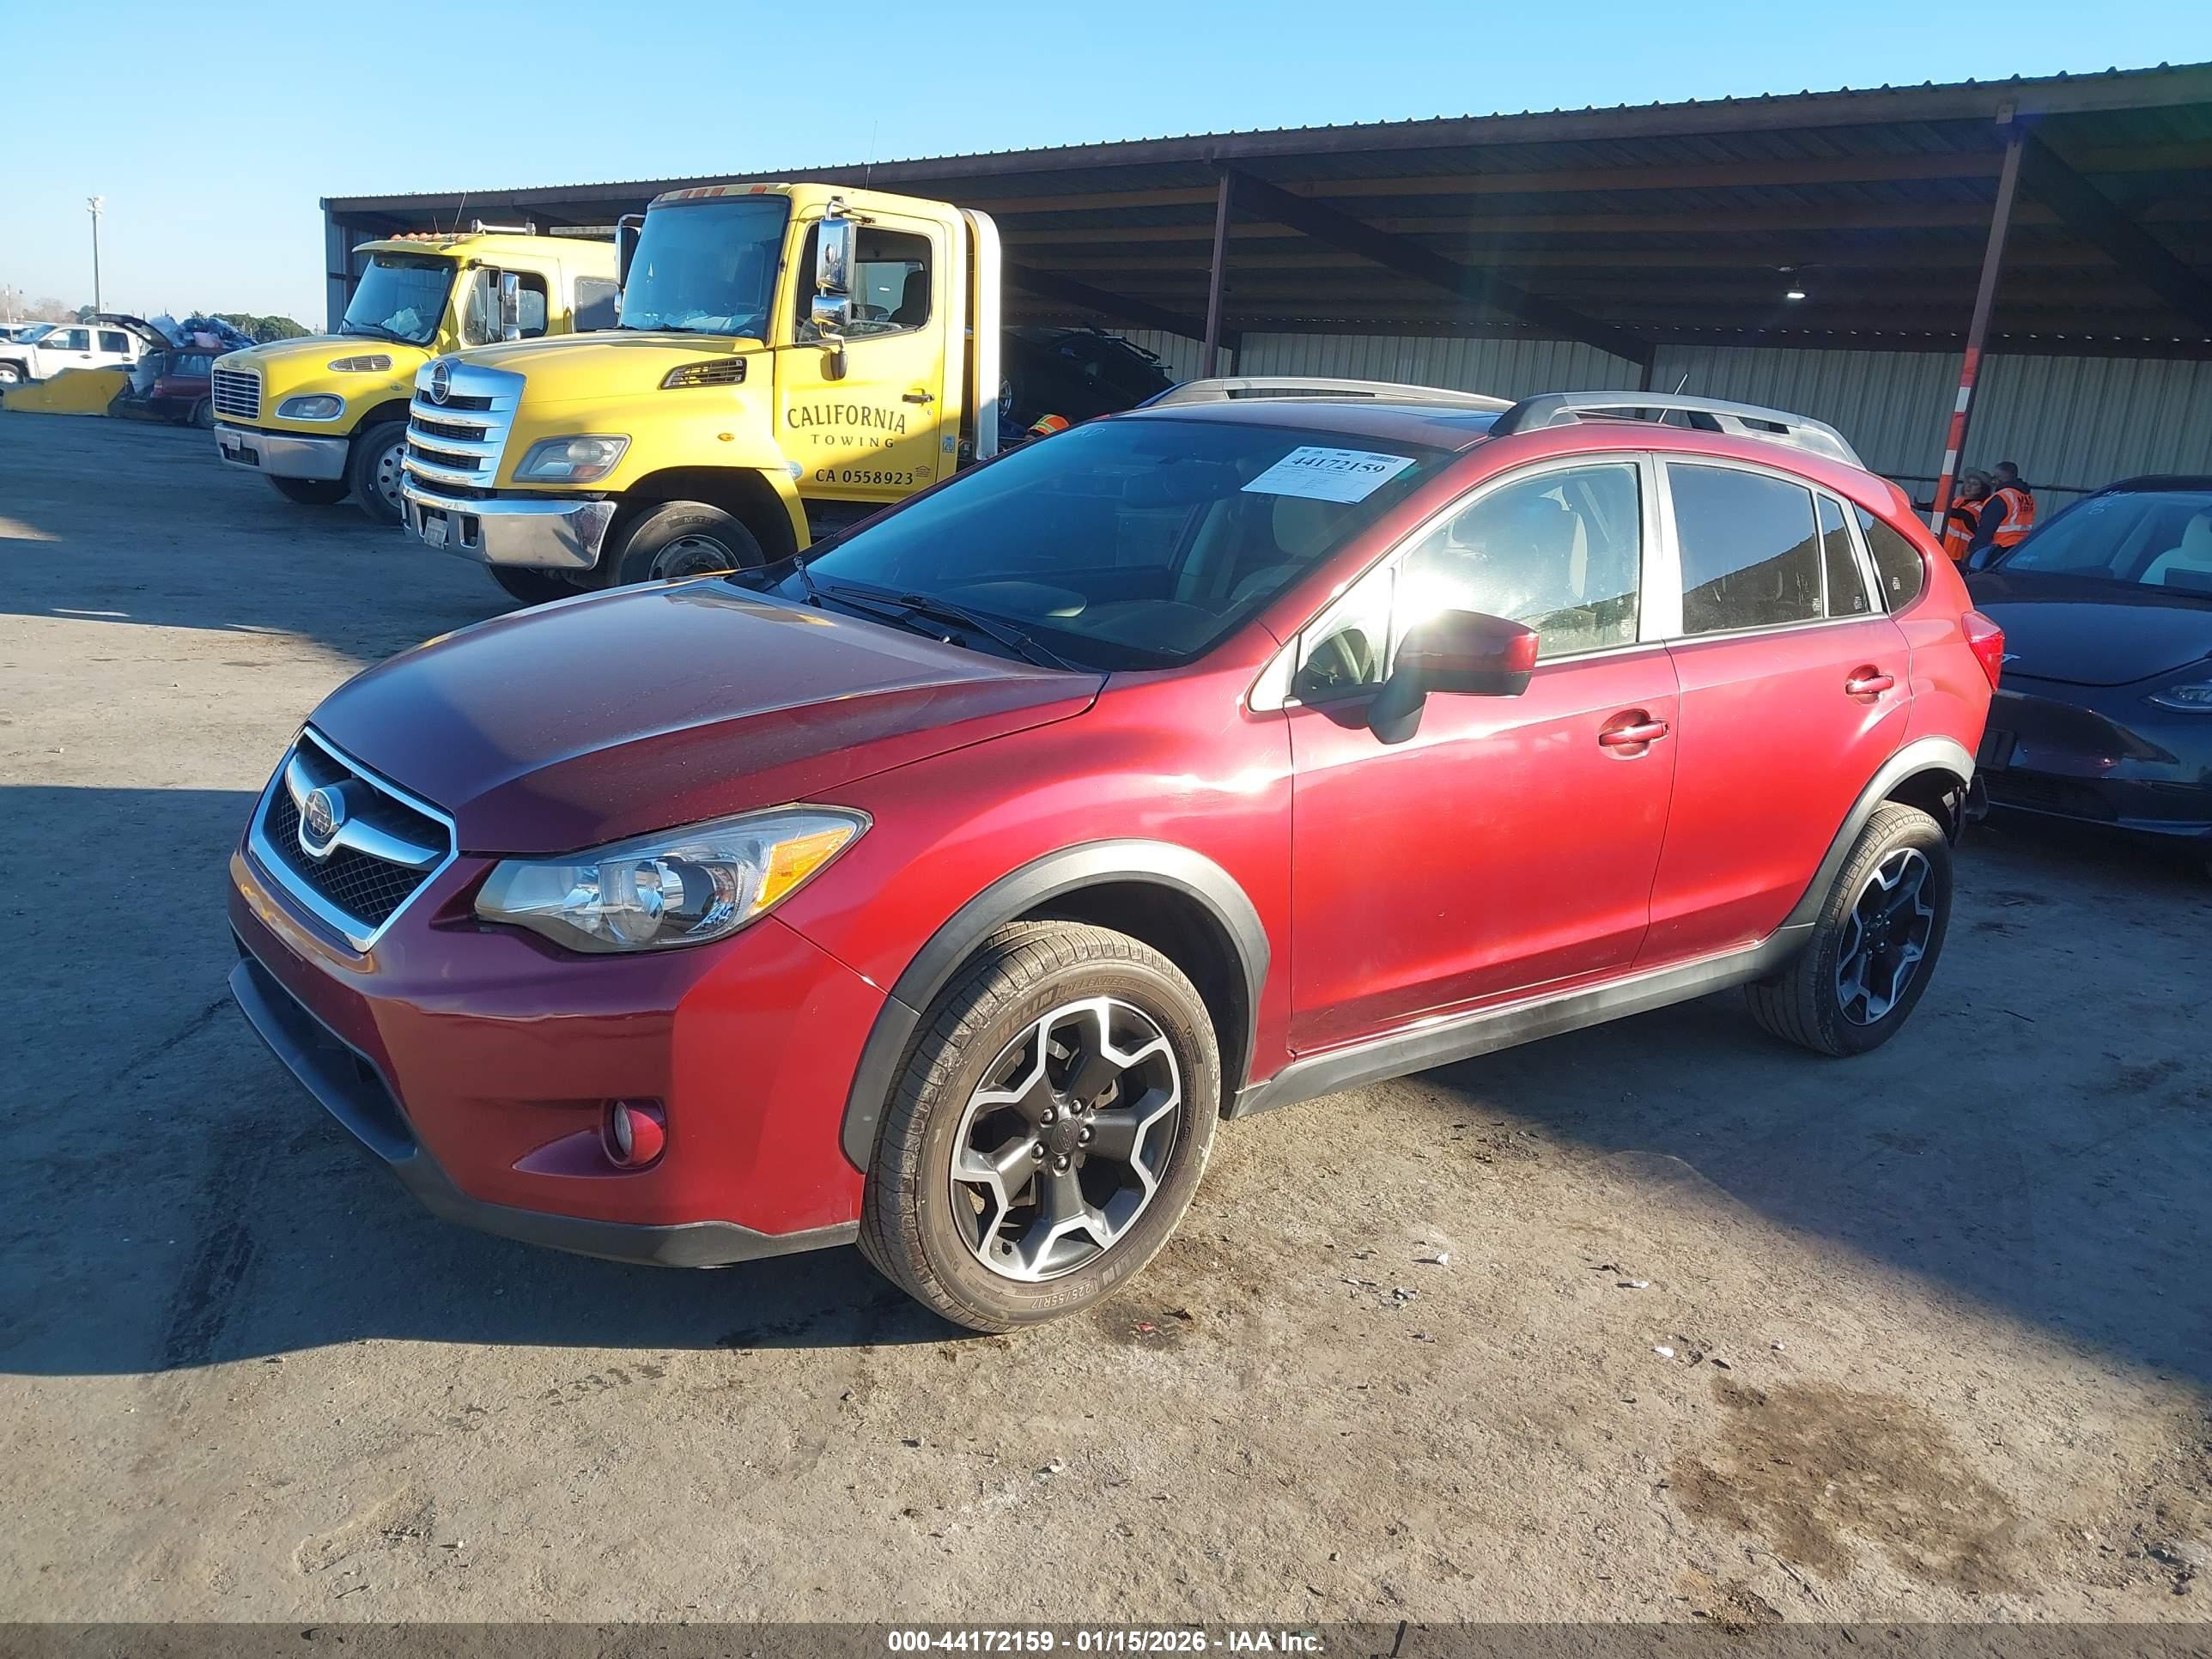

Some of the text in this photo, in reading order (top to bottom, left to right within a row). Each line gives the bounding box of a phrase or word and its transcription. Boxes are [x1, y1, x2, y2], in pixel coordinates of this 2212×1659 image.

[787, 404, 906, 434] CALIFORNIA
[810, 434, 894, 448] TOWING
[1291, 456, 1386, 474] 44172159
[815, 468, 836, 483] CA
[842, 469, 914, 485] 0558923
[1028, 1280, 1091, 1310] 225/55R17
